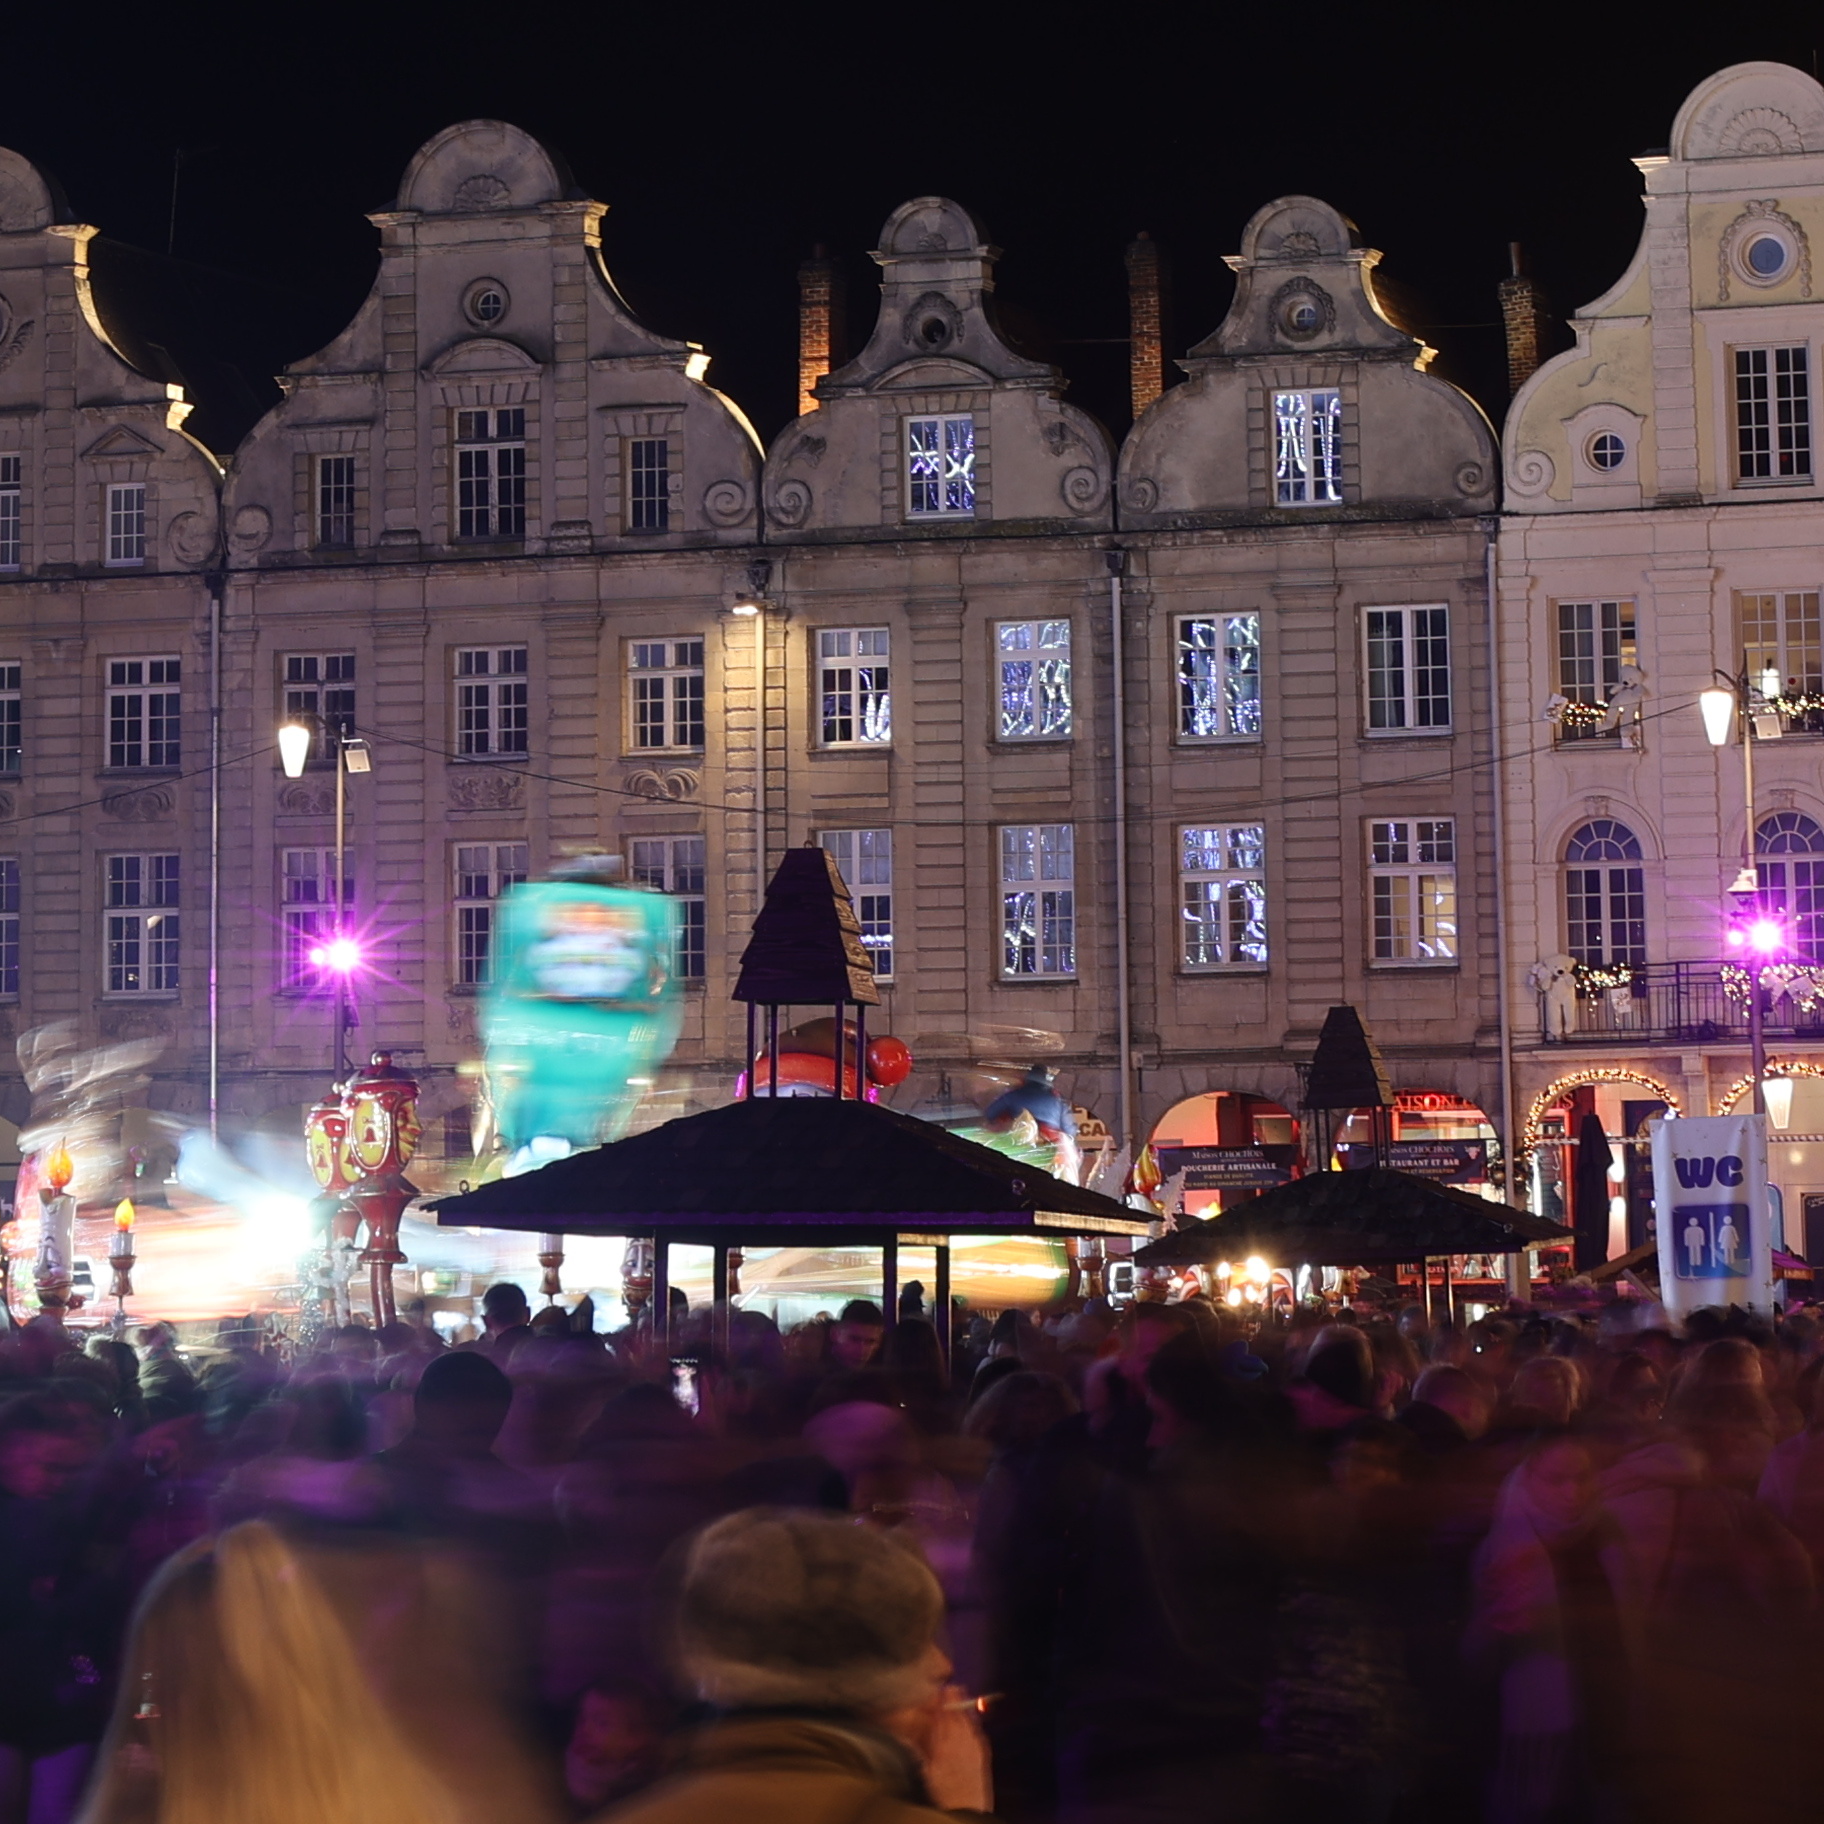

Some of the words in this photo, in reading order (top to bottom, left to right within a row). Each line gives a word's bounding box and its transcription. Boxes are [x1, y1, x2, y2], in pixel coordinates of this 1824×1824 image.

[1443, 1158, 1459, 1166] BAR
[1228, 1163, 1277, 1171] ARTISANALE
[1674, 1155, 1744, 1189] WC
